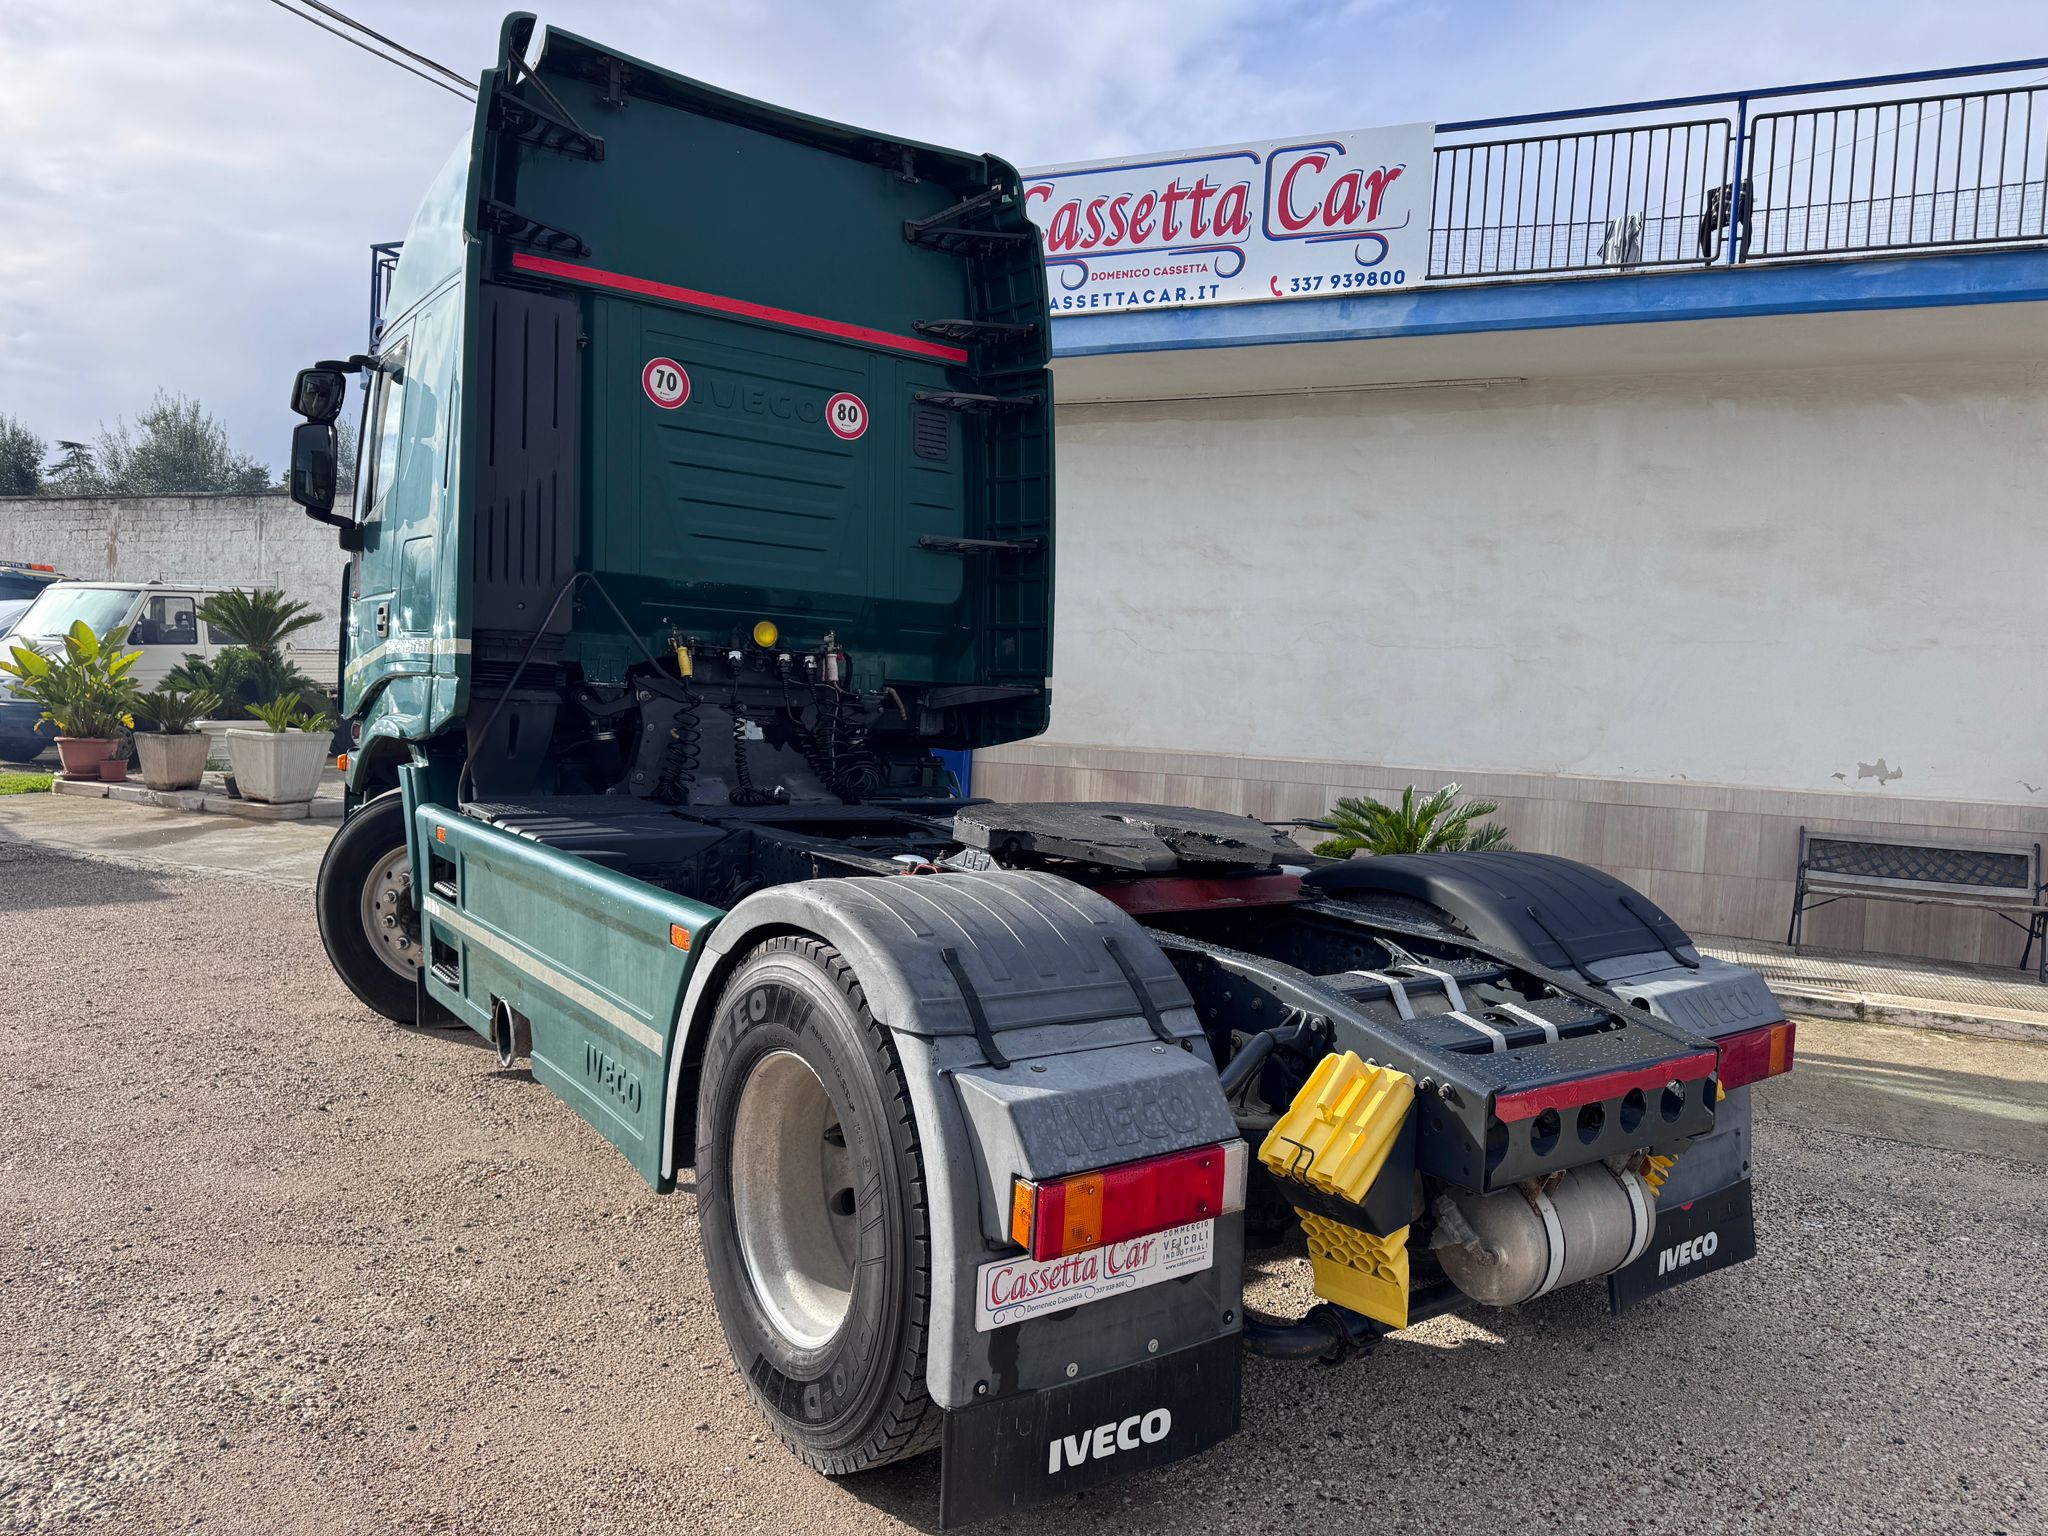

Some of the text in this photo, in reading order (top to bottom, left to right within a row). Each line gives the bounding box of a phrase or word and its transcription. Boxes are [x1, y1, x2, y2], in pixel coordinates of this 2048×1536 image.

[1278, 151, 1407, 231] Car
[1091, 263, 1209, 282] DOMENICO CASSETTA
[1290, 269, 1406, 293] 337 939800
[1049, 284, 1220, 310] ASSETTACAR.IT
[656, 368, 677, 392] 70
[692, 378, 823, 424] IVECO
[837, 403, 858, 423] 80
[1677, 977, 1764, 1030] IVECO
[584, 1040, 642, 1114] IVECO
[1050, 1082, 1200, 1157] IVECO
[1163, 1220, 1209, 1238] COMMERCIO
[1163, 1230, 1209, 1251] VEICOLI
[1162, 1242, 1208, 1260] INDUSTRIALI
[1658, 1231, 1718, 1276] IVECO
[991, 1238, 1156, 1306] Cassetta Car
[1026, 1300, 1057, 1313] Domenico
[1057, 1292, 1083, 1305] Cassetta
[1048, 1407, 1171, 1474] IVECO
